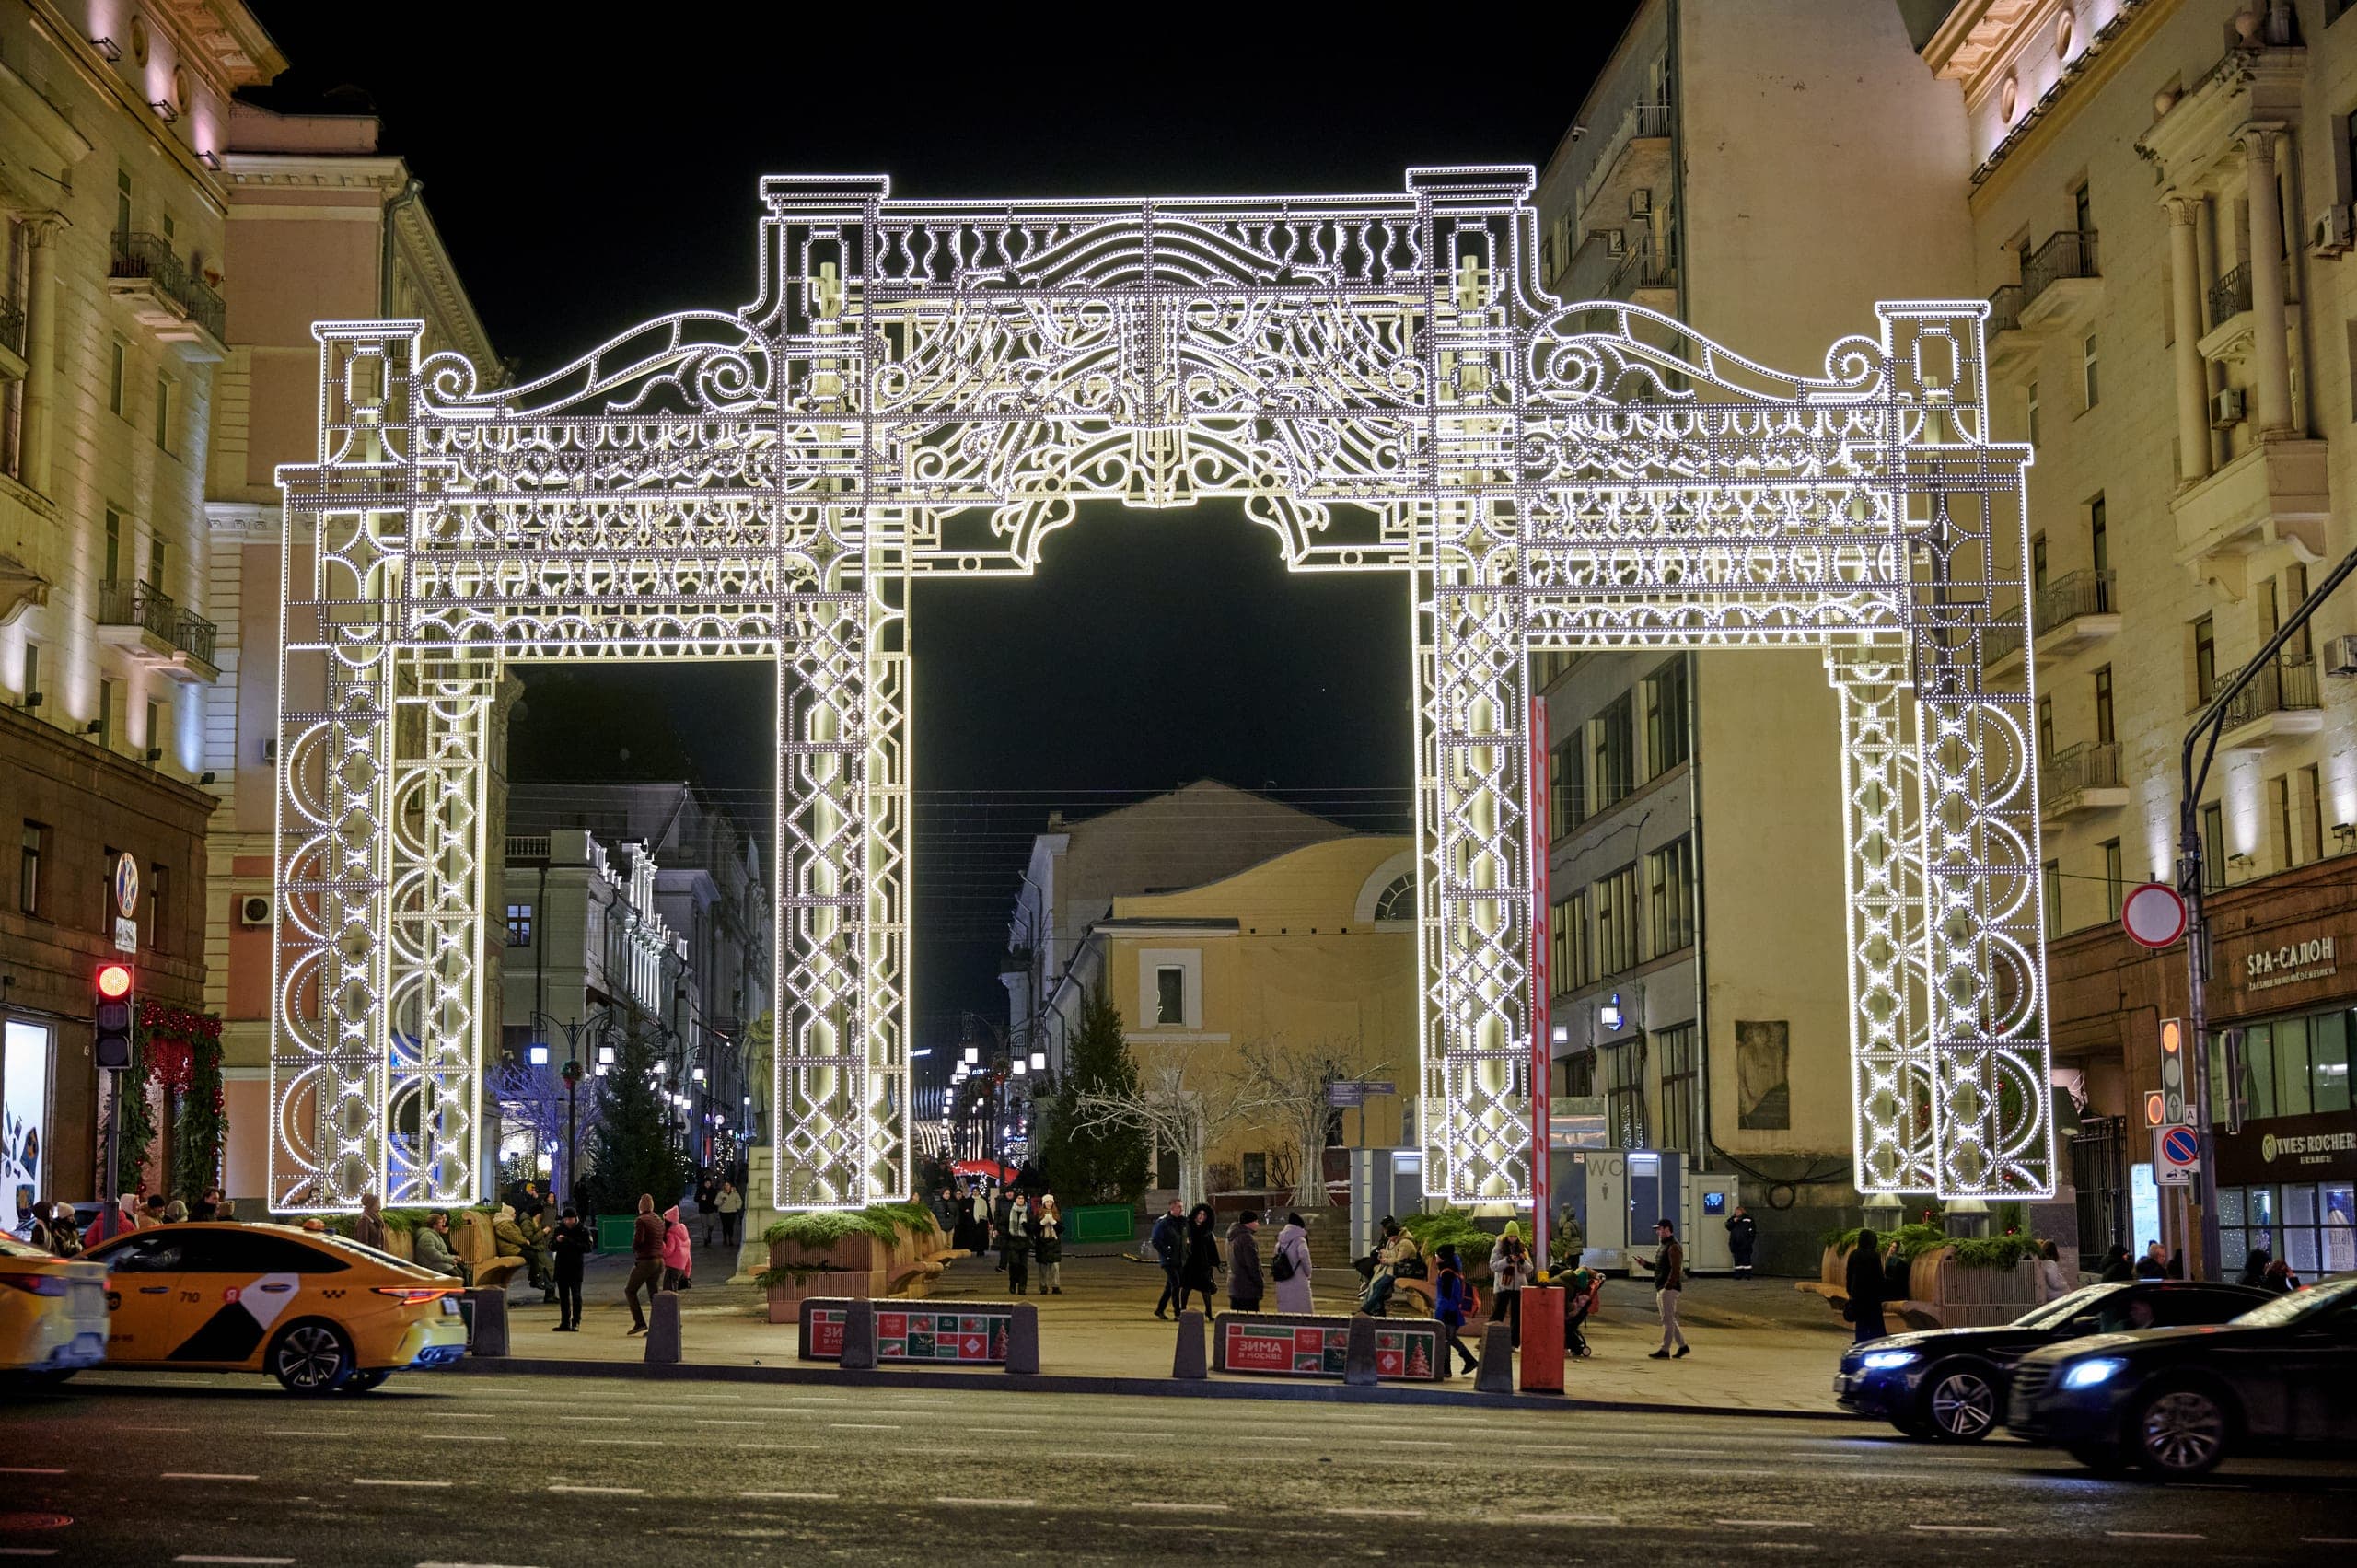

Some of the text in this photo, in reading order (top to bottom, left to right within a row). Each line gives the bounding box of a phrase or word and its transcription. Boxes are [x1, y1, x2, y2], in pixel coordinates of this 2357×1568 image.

[2247, 936, 2334, 975] SPA-САЛОН
[2276, 1132, 2357, 1155] YVES ROCHER
[1587, 1158, 1623, 1177] WC
[823, 1327, 842, 1338] ЗИ
[1238, 1341, 1282, 1353] ЗИМА
